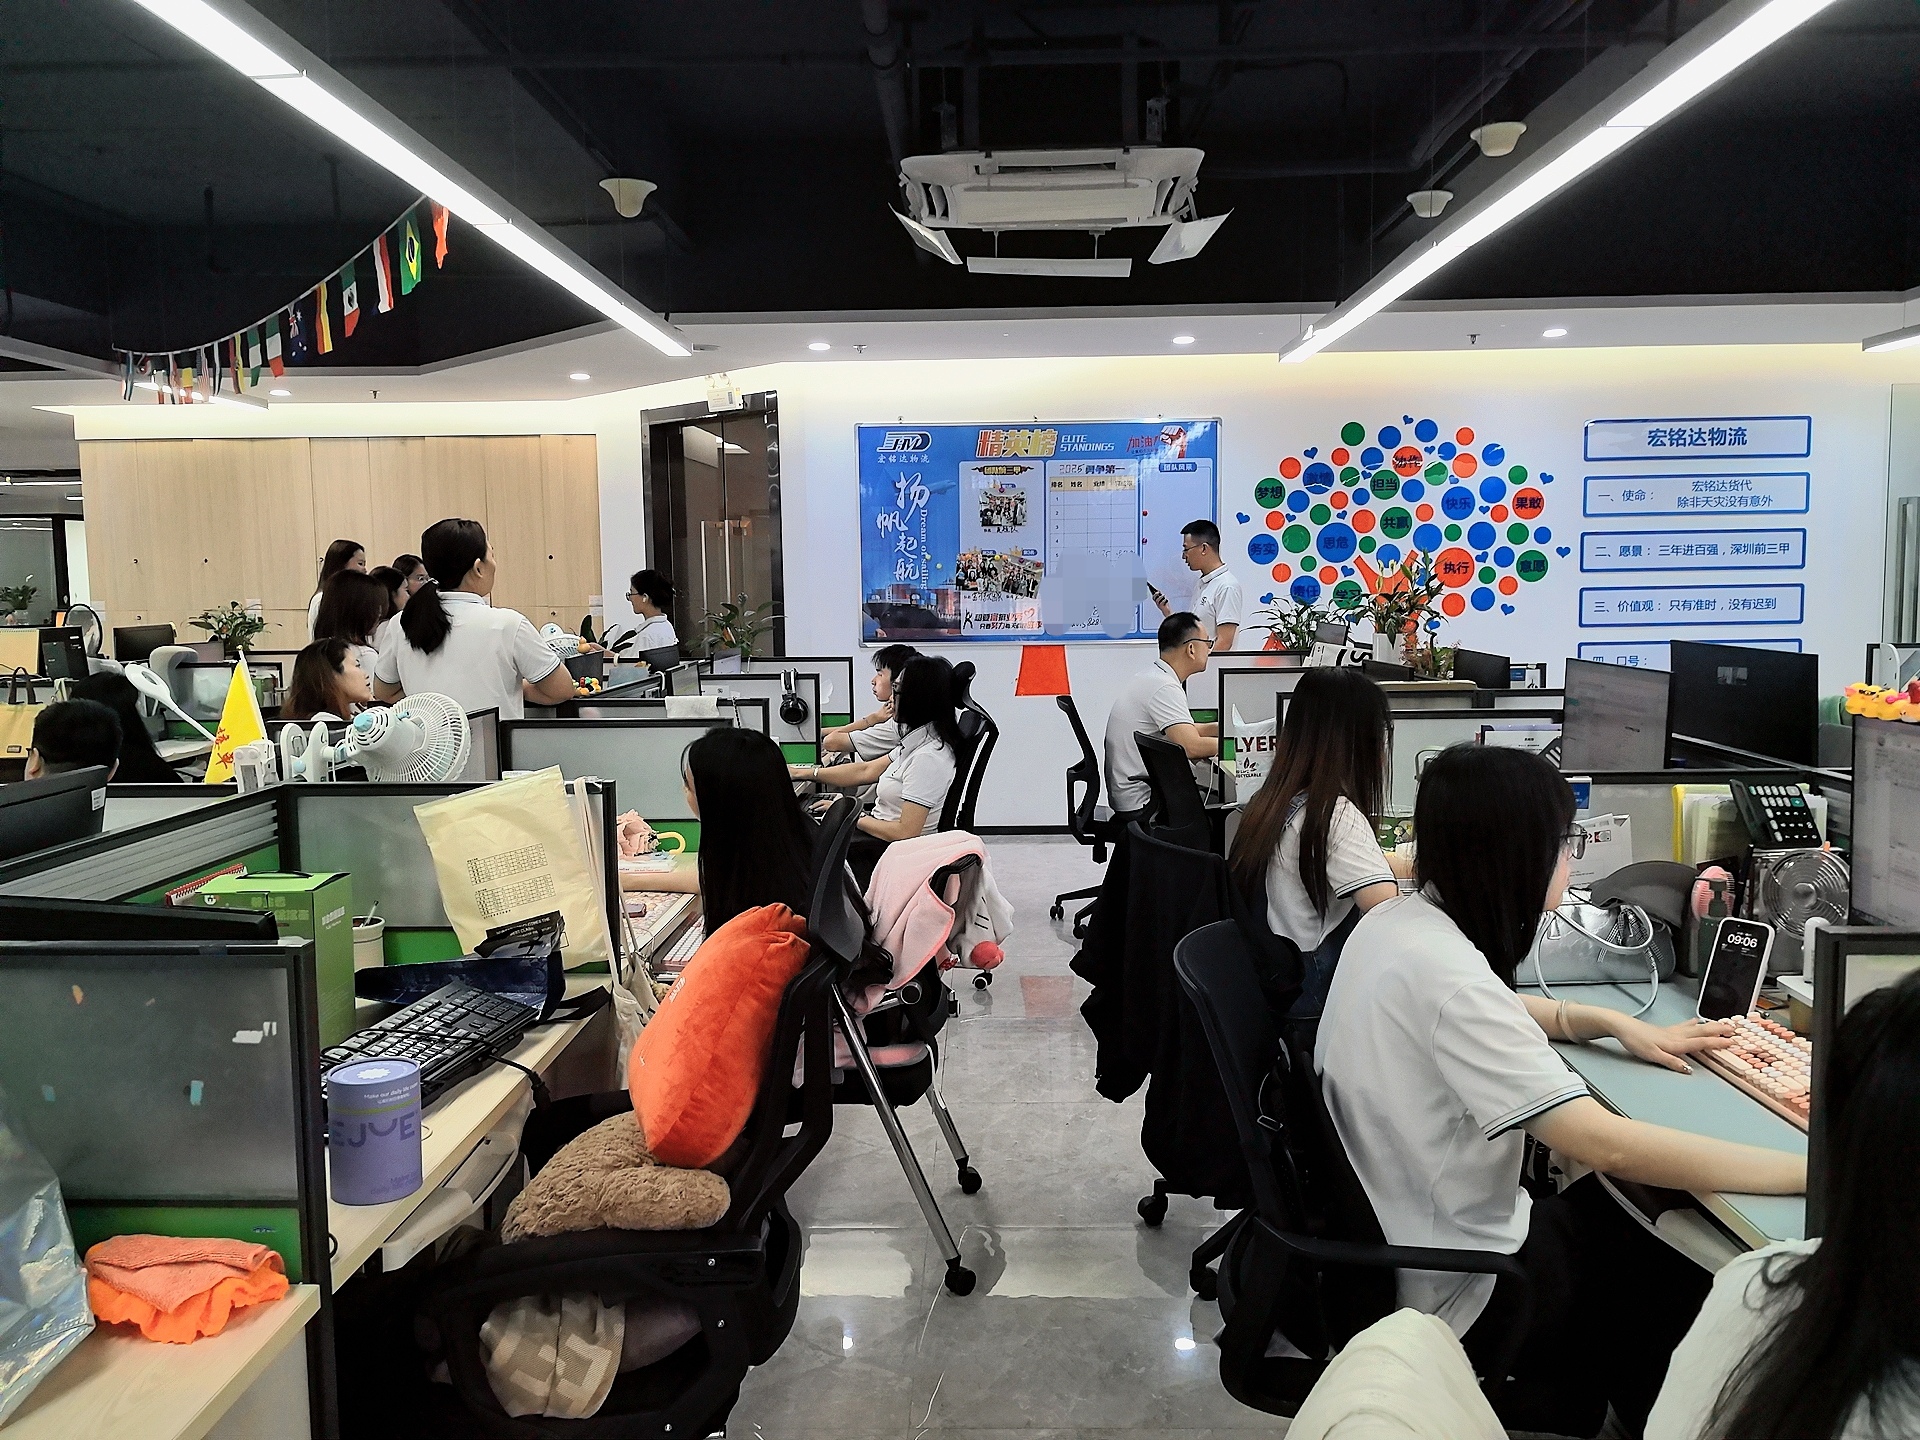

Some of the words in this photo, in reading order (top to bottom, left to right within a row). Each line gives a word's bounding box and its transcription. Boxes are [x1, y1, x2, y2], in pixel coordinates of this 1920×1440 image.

[976, 429, 1058, 458] 精英榜
[1061, 435, 1088, 443] ELITE
[1647, 427, 1747, 448] 宏铭达物流
[1060, 443, 1115, 452] STANDINGS
[877, 454, 930, 463] 宏铭达物流
[1372, 479, 1397, 492] 担当
[1692, 480, 1752, 492] 宏铭达货代
[1257, 486, 1283, 499] 梦想
[1598, 489, 1655, 503] 一、使命：
[1446, 497, 1471, 510] 快乐
[1515, 497, 1542, 509] 果敢
[1677, 495, 1773, 508] 除非天灾没有意外
[876, 471, 931, 582] 扬帆起航
[920, 508, 928, 543] Dream
[1383, 517, 1409, 529] 共赢
[1323, 536, 1349, 549] 思危
[1251, 543, 1275, 556] 务实
[1443, 562, 1469, 575] 执行
[1728, 934, 1758, 948] 09:06
